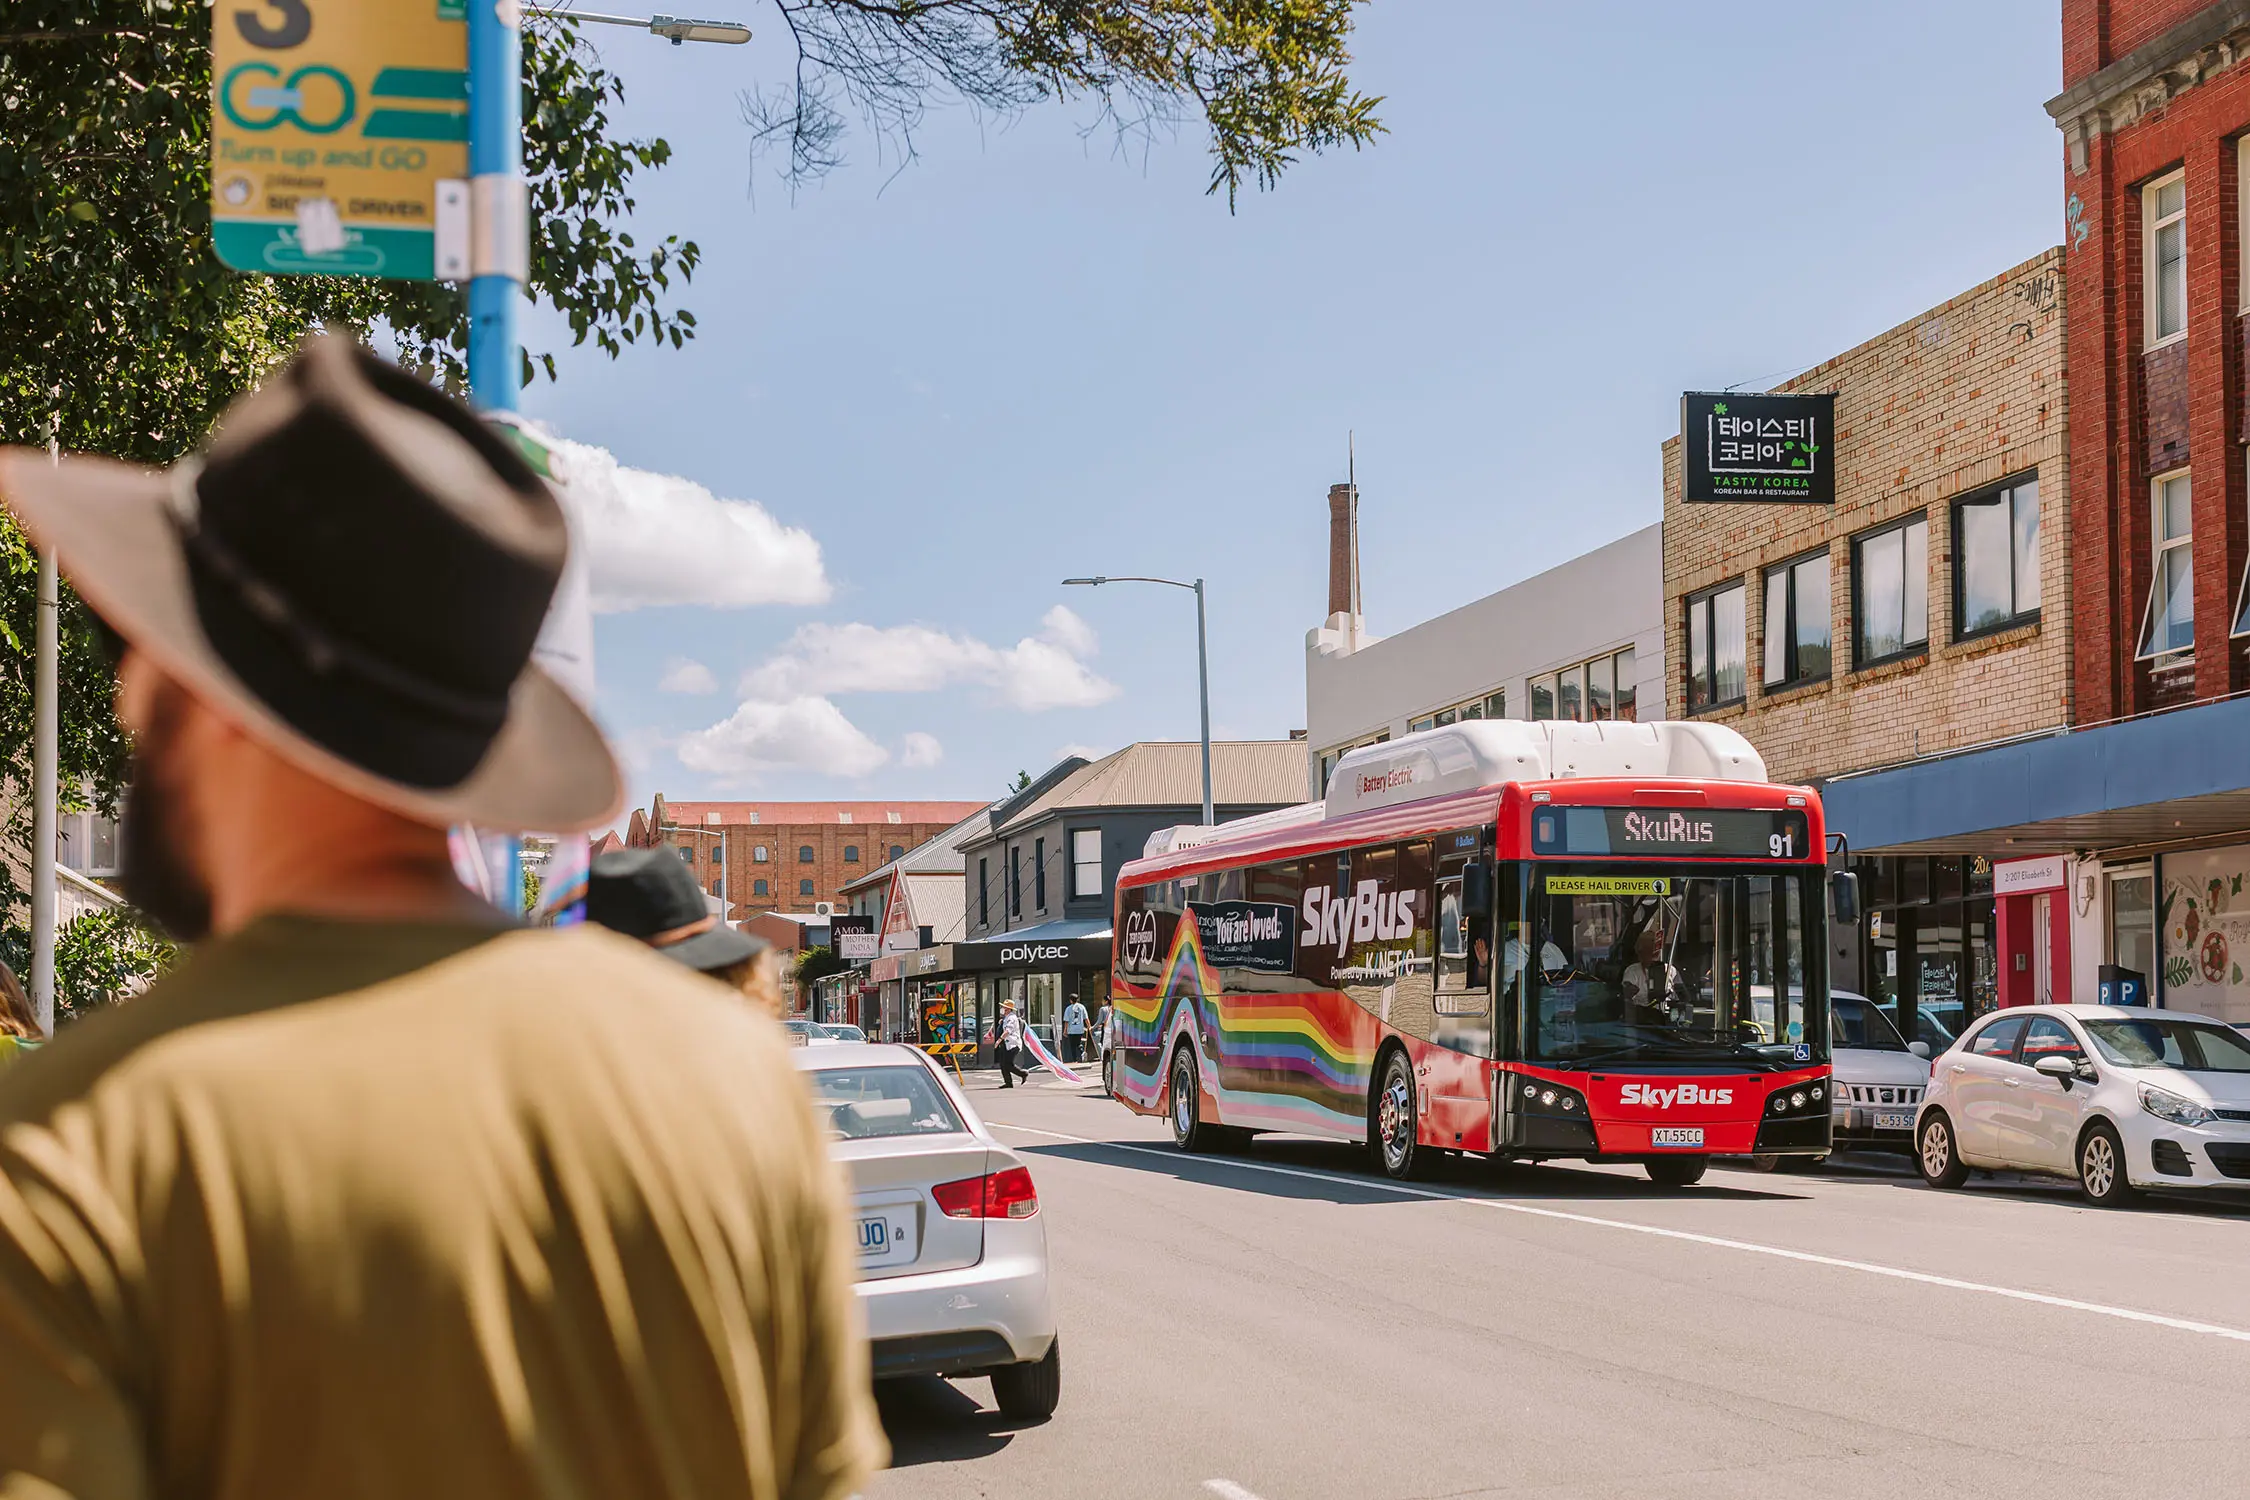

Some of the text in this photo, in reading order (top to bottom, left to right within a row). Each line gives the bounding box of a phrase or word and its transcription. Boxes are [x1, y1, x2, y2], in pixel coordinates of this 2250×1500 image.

[220, 61, 356, 134] GO
[219, 140, 427, 171] Turn up and GO
[1718, 417, 1804, 438] 테이스티
[1720, 442, 1784, 462] 코리아
[1714, 476, 1809, 487] TASTY KOREA
[1363, 766, 1413, 793] Battery Electric
[1769, 834, 1792, 857] 91
[2021, 868, 2045, 880] Elizabeth
[1550, 881, 1650, 891] PLEASE HAIL DRIVER
[1301, 879, 1415, 958] SkyBus
[834, 926, 866, 935] AMOR
[845, 935, 875, 943] MOTHER
[1216, 917, 1232, 944] You
[1233, 918, 1249, 943] are
[920, 952, 937, 970] polytec
[1001, 944, 1068, 964] polytec
[1331, 966, 1354, 980] Powered
[2122, 983, 2133, 1000] P
[1620, 1084, 1733, 1109] SkyBus
[1889, 1116, 1900, 1126] 53
